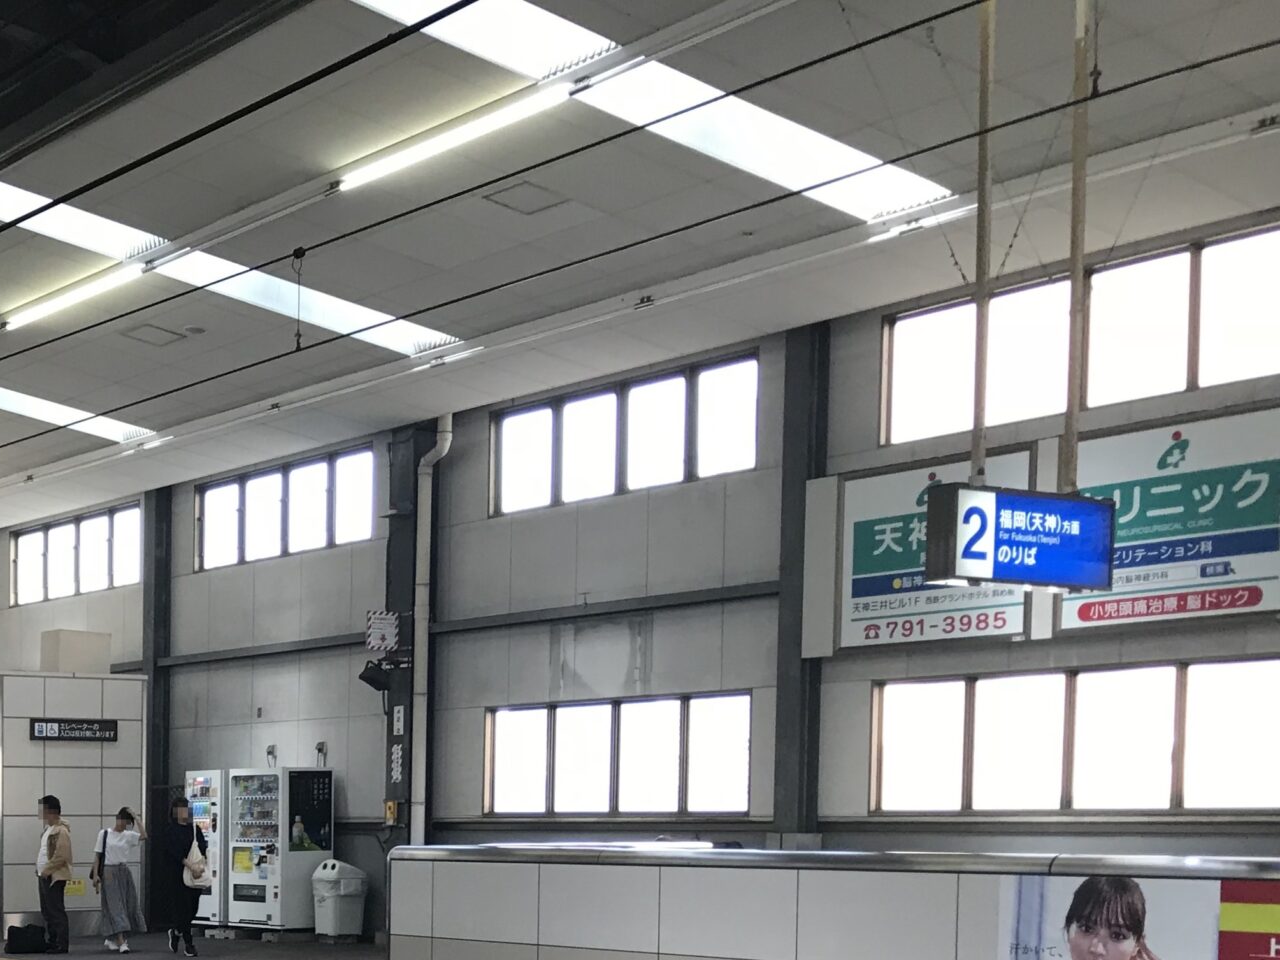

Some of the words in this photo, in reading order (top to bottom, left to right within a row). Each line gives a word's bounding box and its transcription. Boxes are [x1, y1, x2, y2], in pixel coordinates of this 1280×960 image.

[961, 506, 988, 560] 2
[999, 530, 1010, 540] For
[1000, 509, 1080, 535] 福岡(天神)方面
[998, 545, 1037, 566] のりば
[886, 611, 1007, 639] 791-3985
